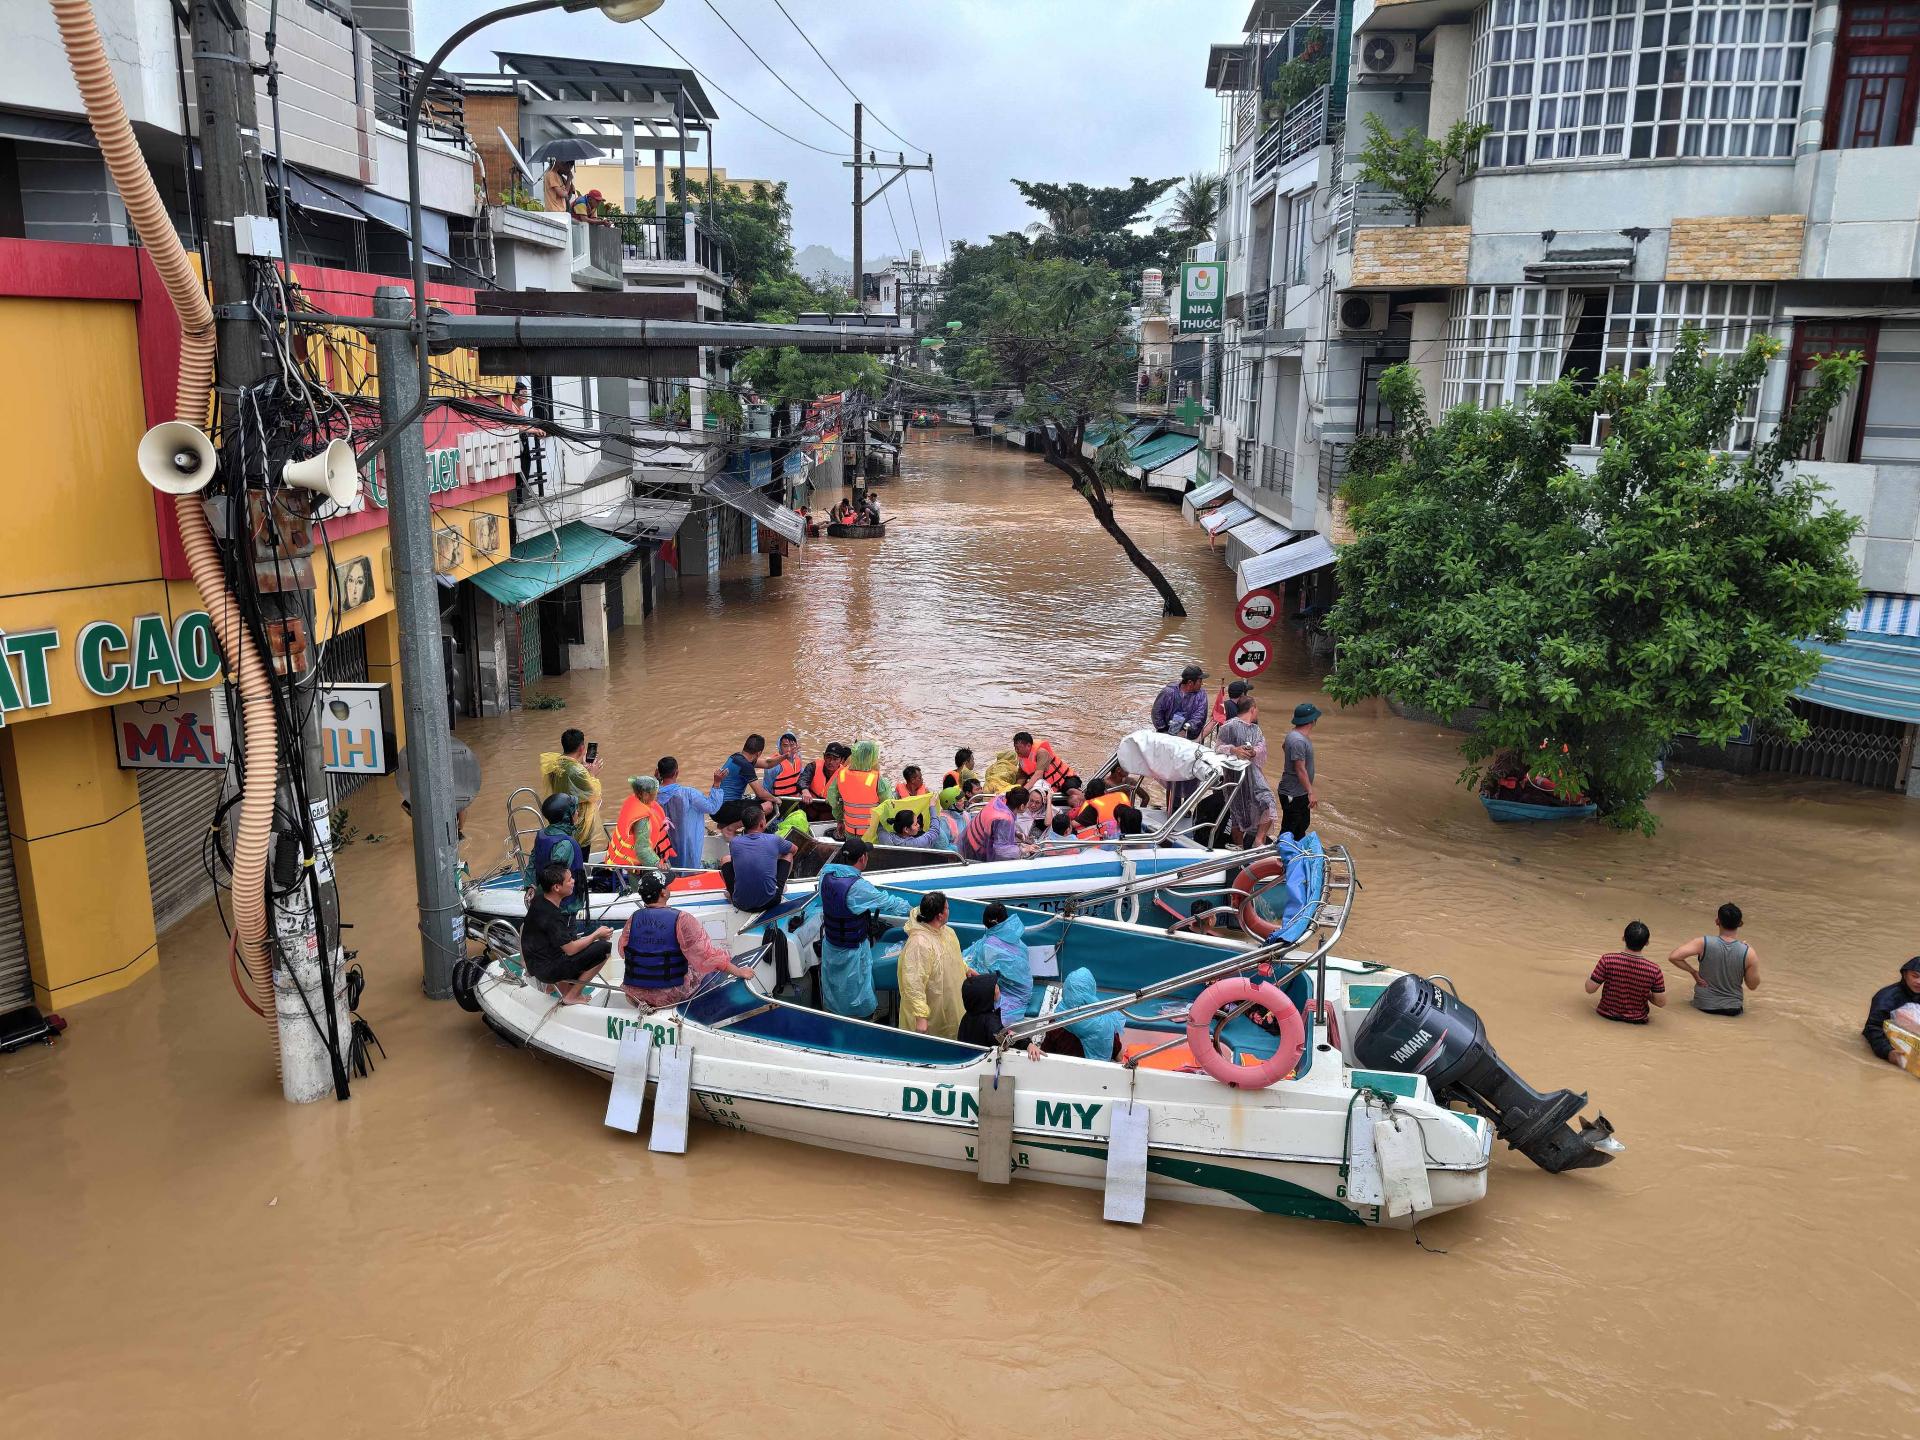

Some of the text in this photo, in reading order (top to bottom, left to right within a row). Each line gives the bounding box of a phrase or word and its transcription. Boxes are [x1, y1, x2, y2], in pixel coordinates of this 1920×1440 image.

[1182, 316, 1221, 329] THUỐC
[1189, 303, 1213, 314] NHÀ
[76, 611, 222, 696] CAO
[1390, 1028, 1433, 1064] YAMAHA
[1035, 1099, 1103, 1130] MY
